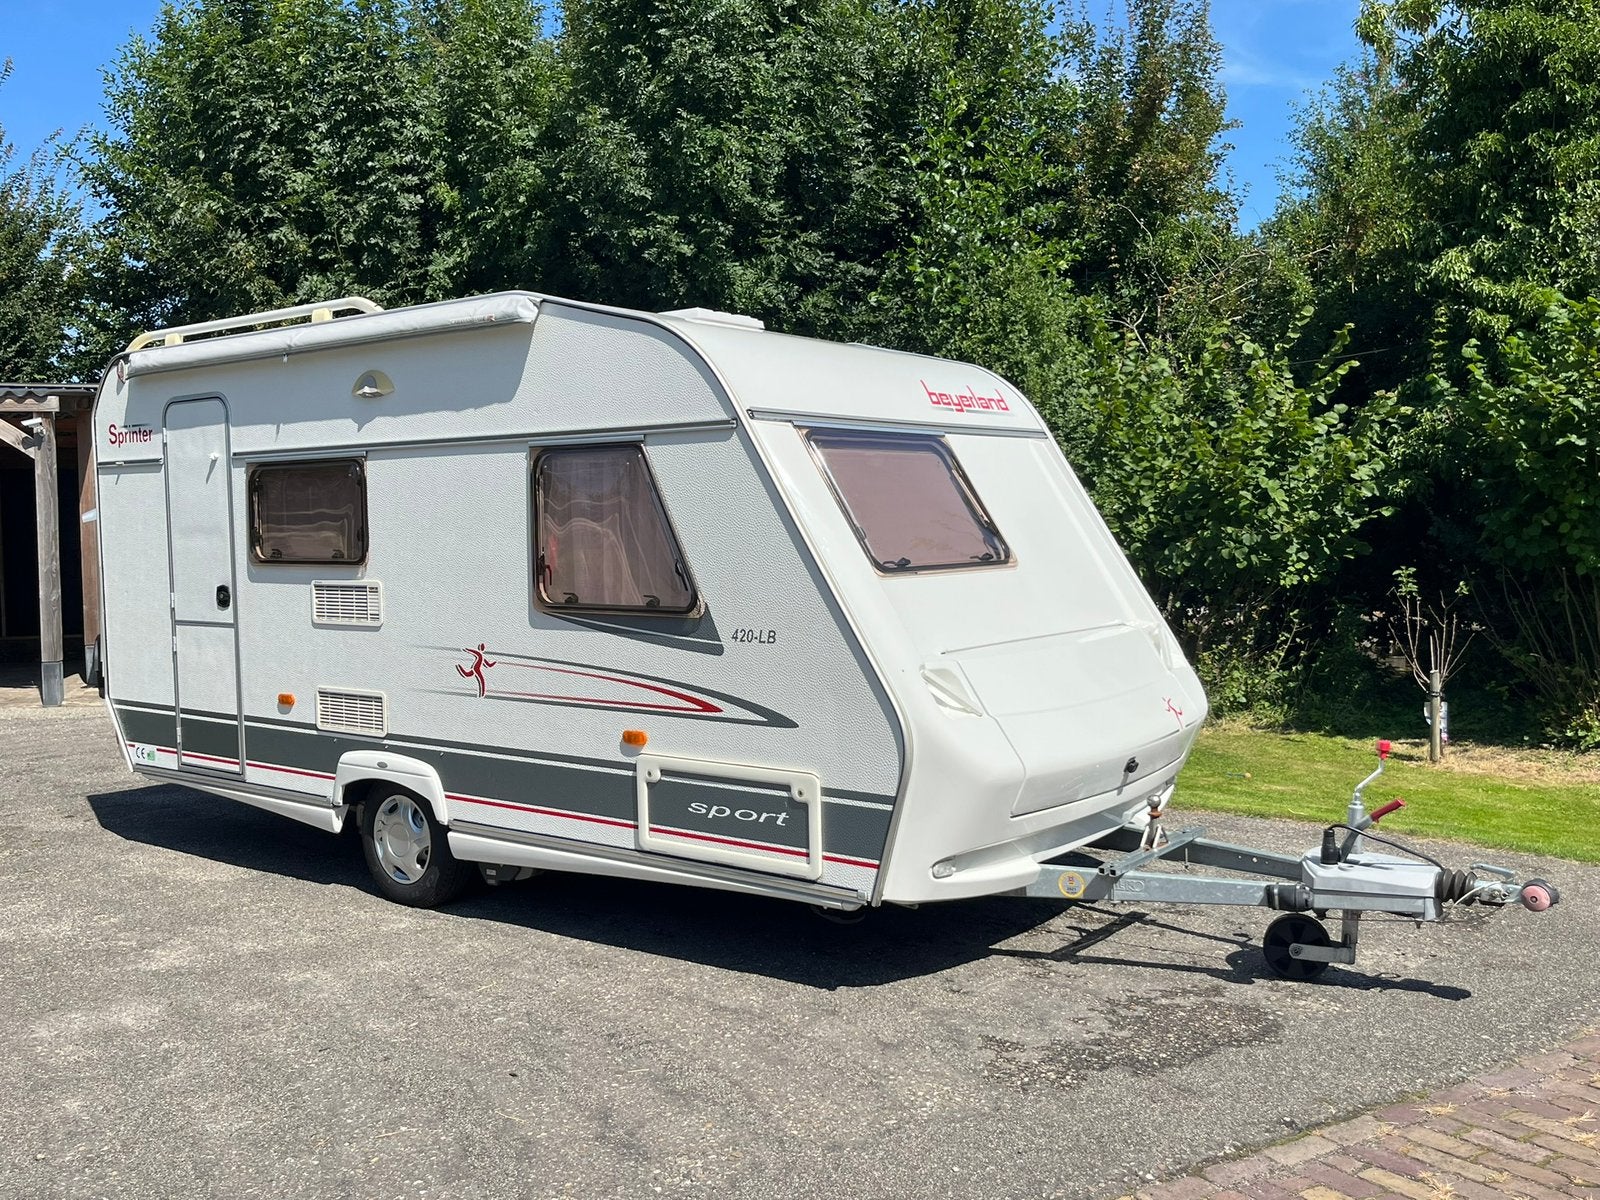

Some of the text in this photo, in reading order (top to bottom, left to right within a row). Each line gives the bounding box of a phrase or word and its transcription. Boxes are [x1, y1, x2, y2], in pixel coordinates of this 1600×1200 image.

[920, 379, 1009, 412] beyerland
[109, 424, 153, 448] Sprinter
[731, 628, 776, 644] 420-LB
[136, 747, 145, 760] CE
[688, 802, 789, 826] sport
